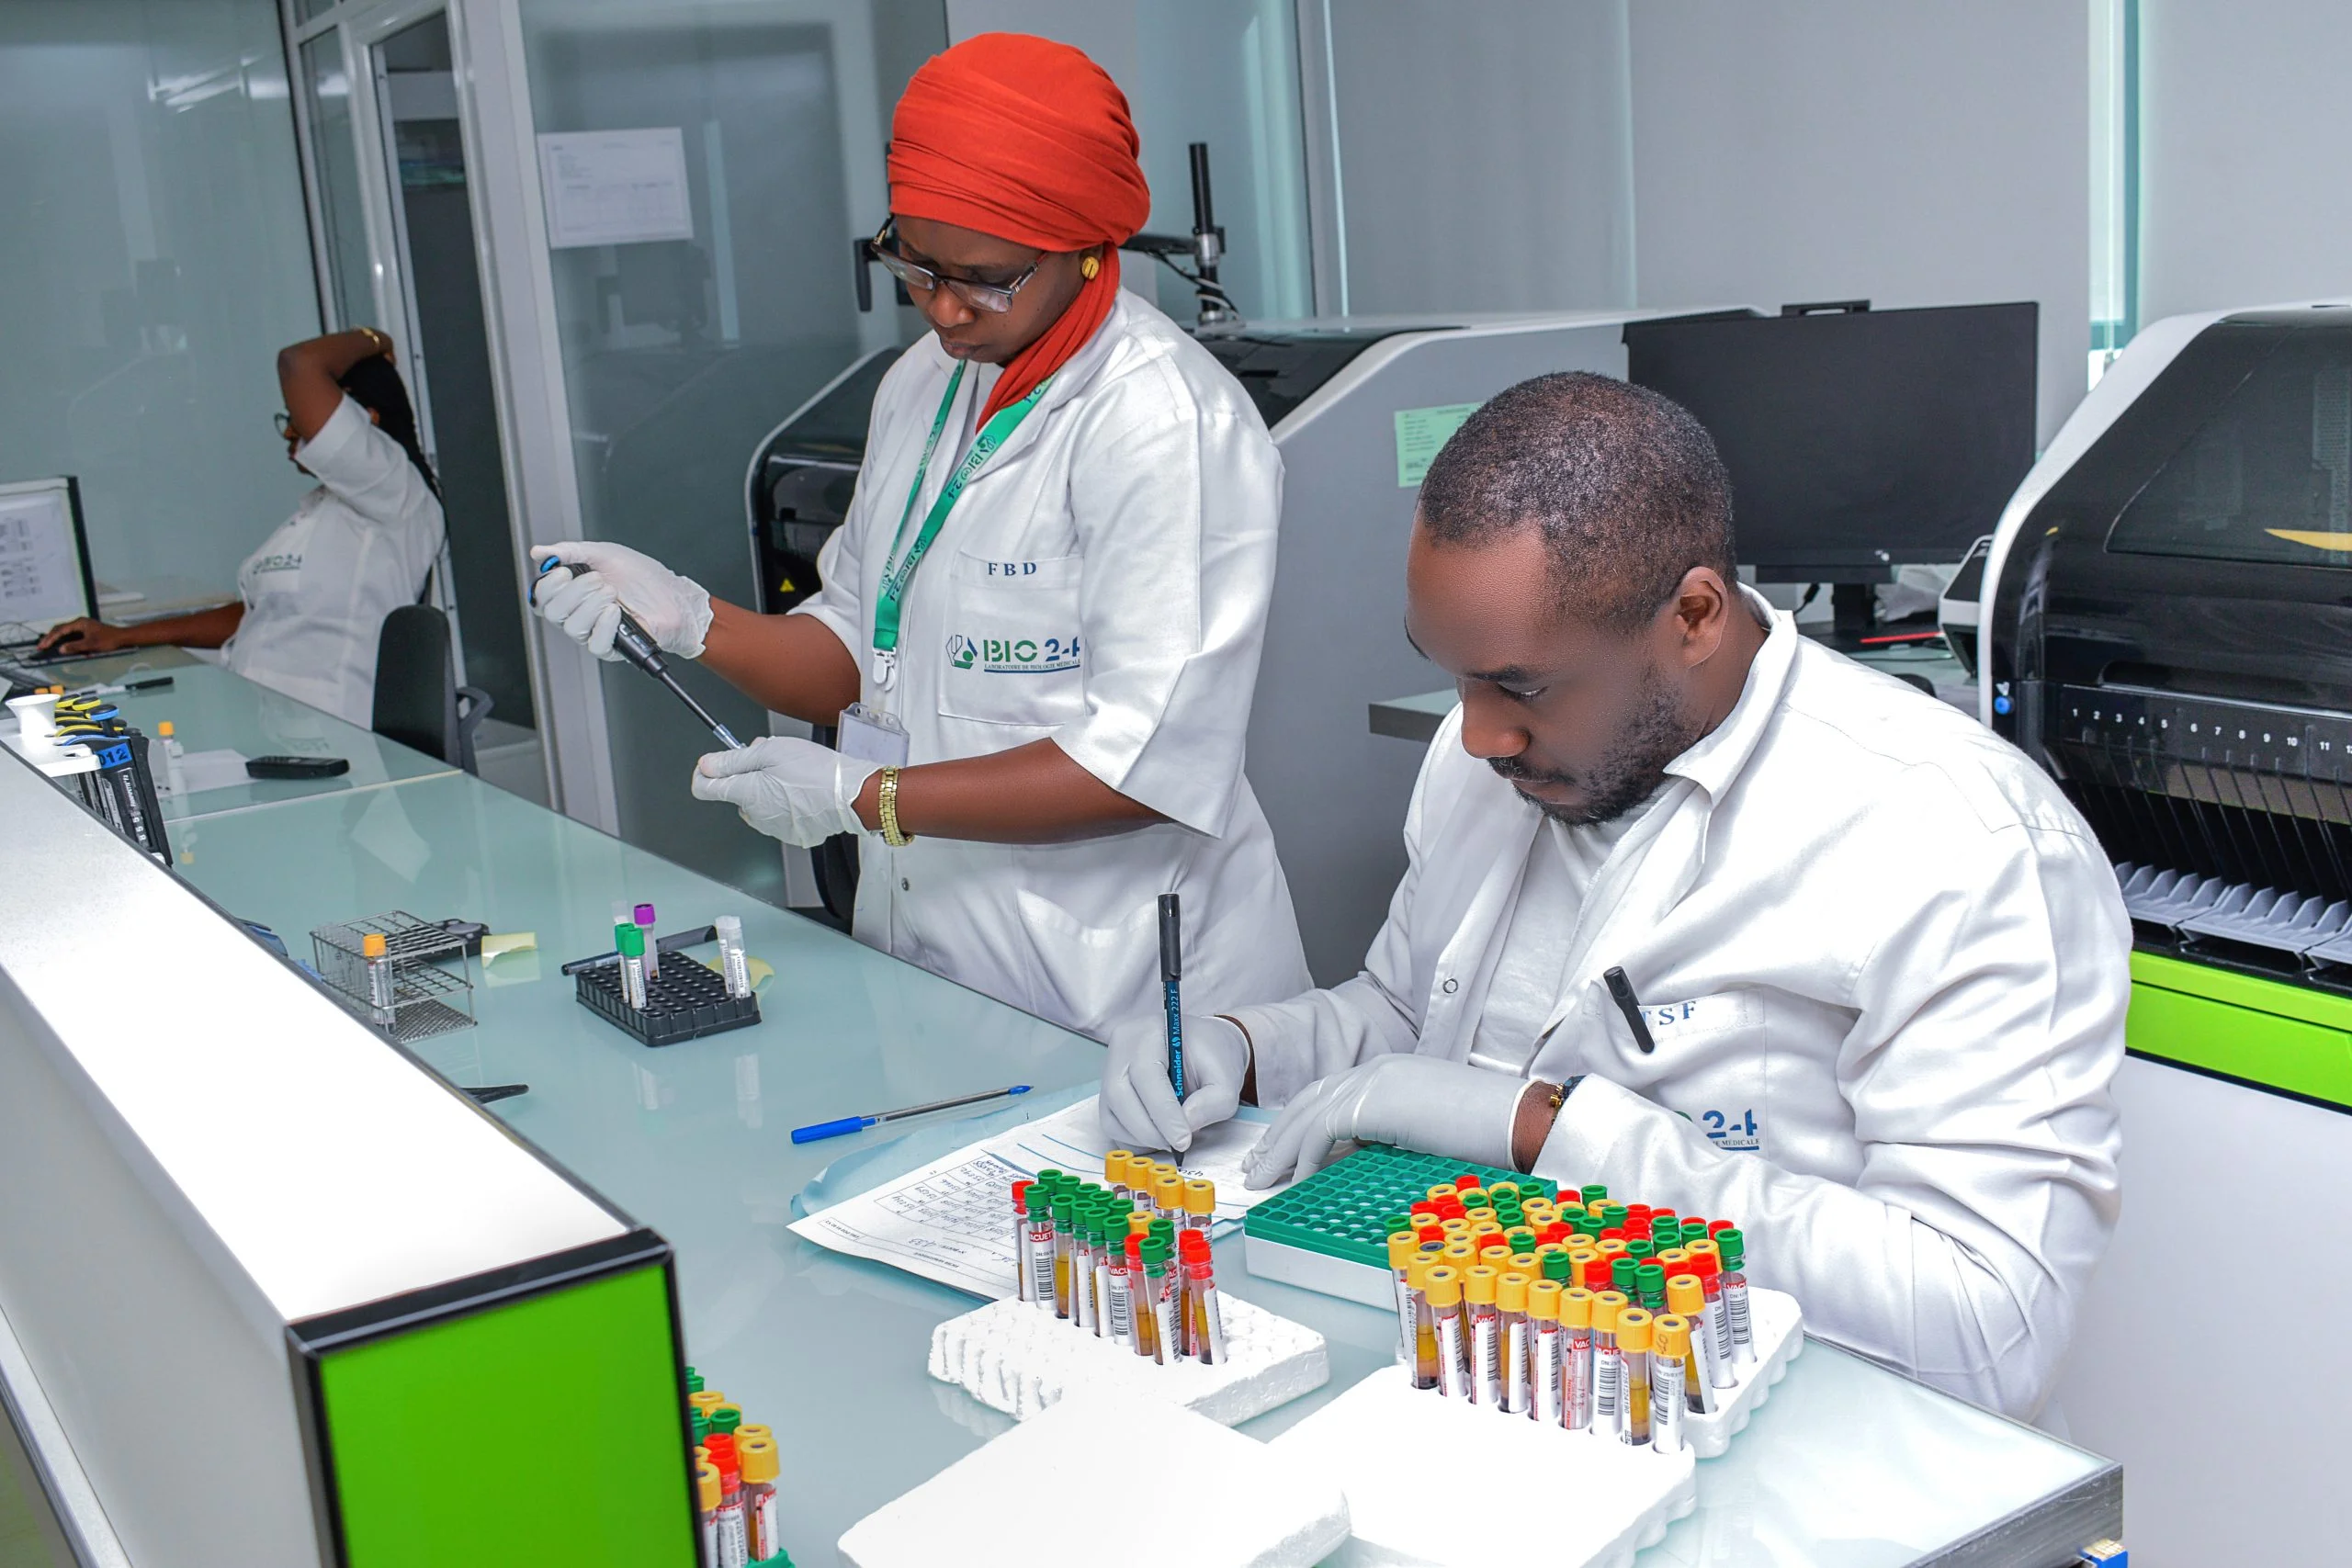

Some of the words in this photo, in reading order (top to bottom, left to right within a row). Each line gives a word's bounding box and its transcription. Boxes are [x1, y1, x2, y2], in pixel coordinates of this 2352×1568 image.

[1045, 637, 1080, 661] 24
[2072, 708, 2078, 717] 1
[2093, 710, 2100, 720] 2
[2115, 713, 2122, 723] 3
[2137, 716, 2145, 725] 4
[2161, 719, 2168, 728] 5
[2190, 723, 2198, 733] 6
[2214, 726, 2222, 736] 7
[2239, 729, 2246, 739] 8
[2263, 732, 2271, 742] 9
[2287, 737, 2298, 747] 10
[2319, 740, 2331, 751] 11
[1170, 995, 1180, 1011] 222
[1172, 1013, 1181, 1035] Maxx
[1174, 1050, 1183, 1097] Schneider
[1702, 1109, 1758, 1139] 24
